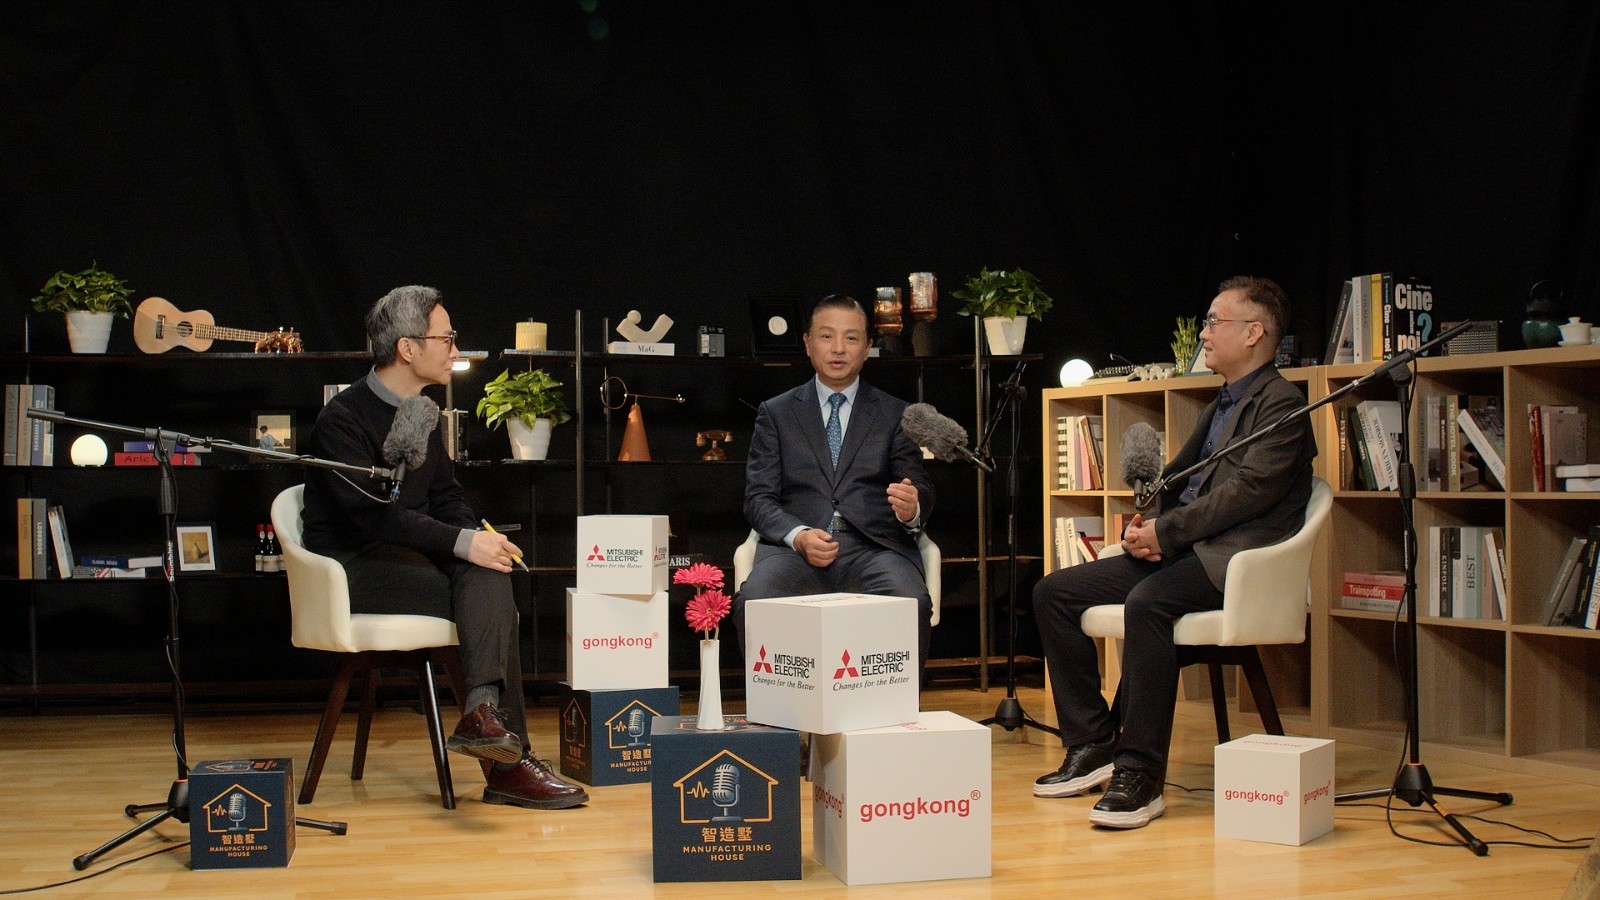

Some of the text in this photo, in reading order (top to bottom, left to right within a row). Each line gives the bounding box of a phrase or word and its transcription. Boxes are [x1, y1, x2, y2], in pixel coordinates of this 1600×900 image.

[1395, 283, 1433, 312] Cine
[1384, 304, 1392, 324] Cine
[1397, 330, 1421, 352] noi
[606, 548, 644, 556] MITSUBISHI
[669, 557, 690, 567] ARIS
[1466, 555, 1475, 589] BEST
[1349, 584, 1386, 600] Trainspotting
[774, 653, 815, 669] MITSUBISHI
[861, 650, 910, 666] MITSUBISHI
[774, 664, 810, 679] ELECTRIC
[861, 662, 904, 677] ELECTRIC
[752, 674, 815, 691] Changes for the Better
[832, 681, 863, 692] Changes
[864, 680, 876, 688] for
[889, 676, 910, 685] Better
[610, 760, 652, 768] MANUFACTUR
[702, 826, 753, 843] 智造墅
[682, 844, 772, 853] MANUFACTURING
[710, 853, 745, 861] HOUSE
